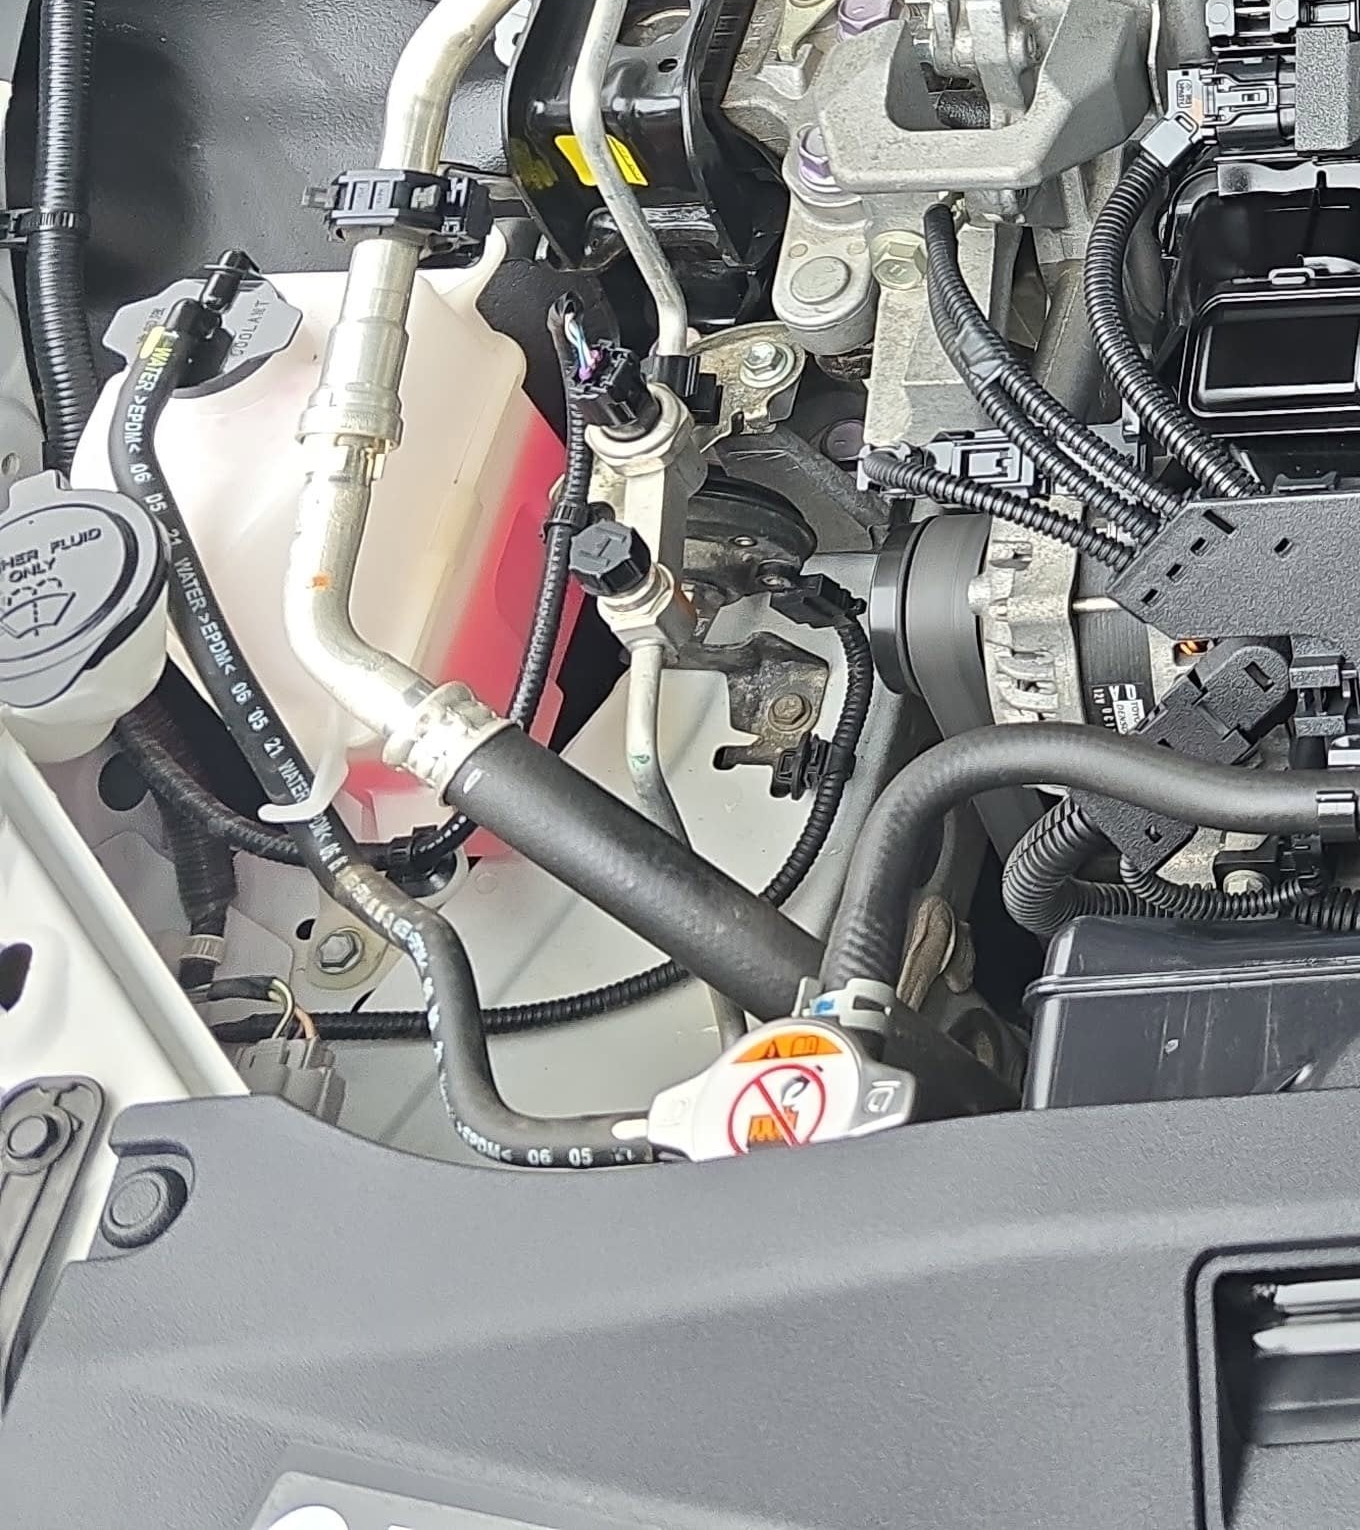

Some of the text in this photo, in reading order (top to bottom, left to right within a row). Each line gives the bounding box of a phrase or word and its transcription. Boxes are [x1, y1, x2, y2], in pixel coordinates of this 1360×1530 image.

[230, 299, 271, 357] COOLANT
[134, 347, 173, 392] WATER
[124, 395, 149, 454] >EPDM<
[129, 463, 153, 484] 06
[50, 527, 102, 554] FLUID
[9, 557, 56, 583] ONLY
[173, 557, 208, 613] WATER
[198, 612, 237, 676] >EPDM<
[230, 681, 254, 705] 06
[527, 1148, 552, 1166] 06
[567, 1147, 593, 1166] 05
